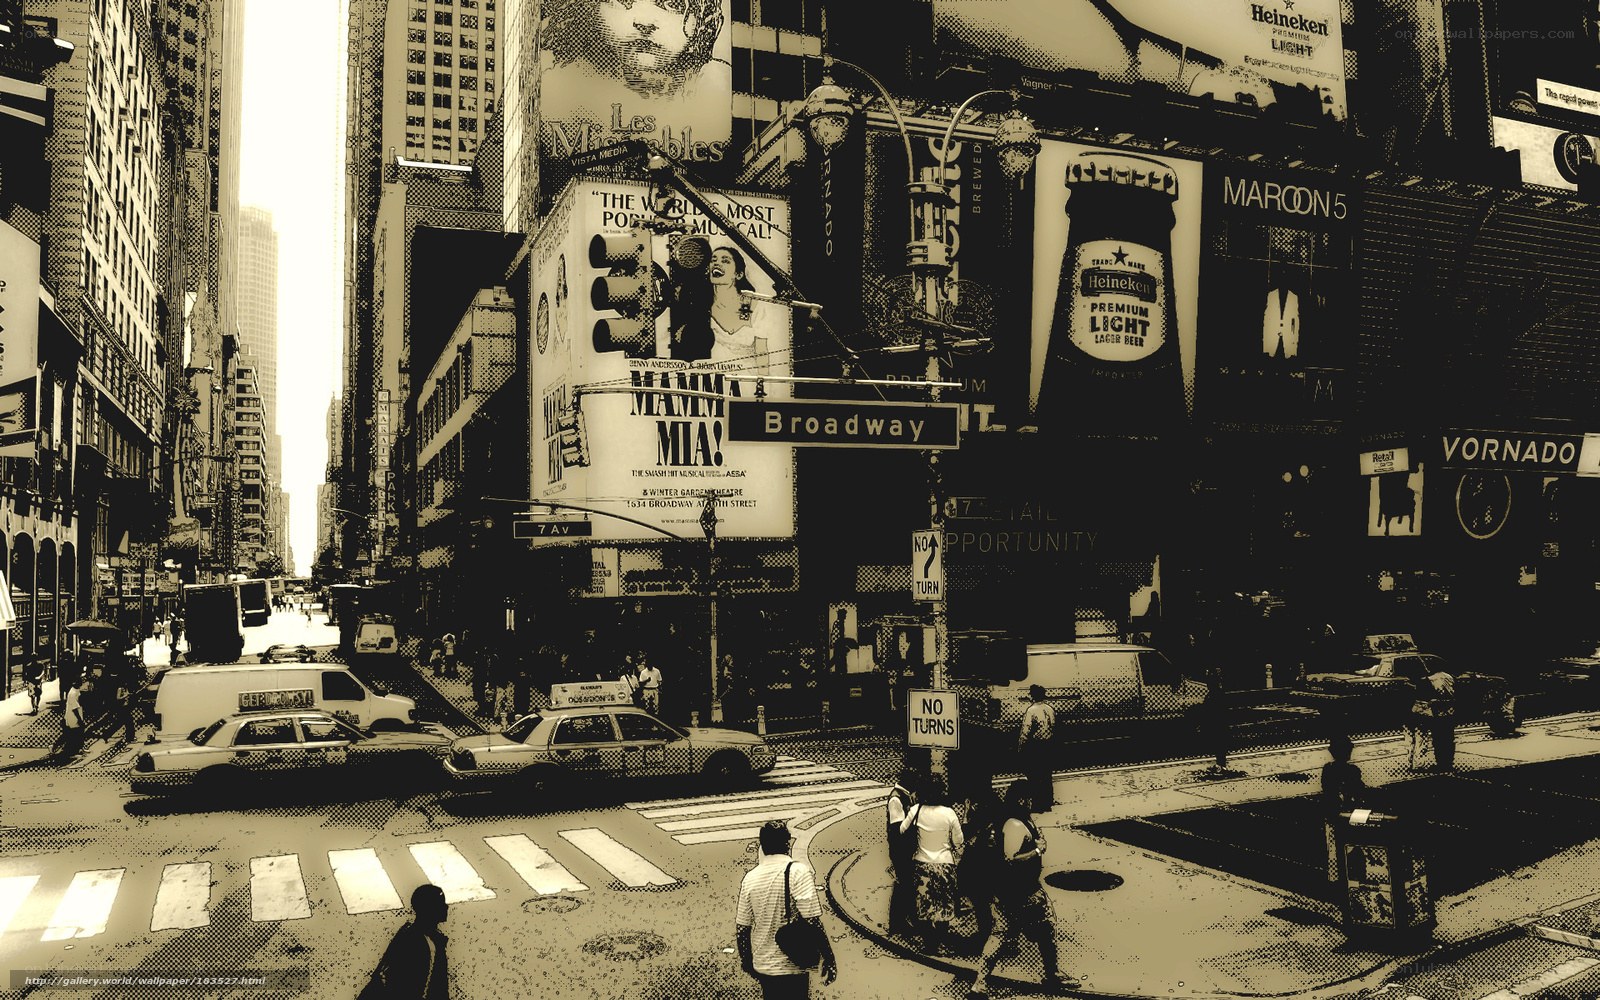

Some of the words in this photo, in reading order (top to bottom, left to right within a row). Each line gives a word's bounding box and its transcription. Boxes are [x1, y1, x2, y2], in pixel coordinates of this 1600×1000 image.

[1251, 4, 1329, 37] Heineken
[1271, 39, 1314, 58] LIGHT
[611, 102, 657, 133] Les
[571, 156, 597, 166] VISTA
[600, 146, 629, 160] MEDIA
[972, 142, 982, 214] BREWED
[1224, 176, 1330, 218] MAROON
[1333, 193, 1347, 220] 5
[726, 203, 775, 222] MOST
[1127, 261, 1146, 271] MARK
[1089, 274, 1151, 295] Heineken
[1090, 302, 1149, 318] PREMIUM
[1090, 315, 1151, 337] LIGHT
[1095, 334, 1121, 344] LAGER
[1124, 335, 1145, 348] BEER
[764, 410, 925, 442] Broadway
[655, 419, 724, 467] MIA!
[1442, 435, 1576, 464] VORNADO
[1372, 451, 1395, 462] Retail
[644, 469, 667, 477] SMASH
[387, 472, 396, 511] PARK
[649, 488, 679, 496] WINTER
[648, 500, 694, 508] BROADWAY
[730, 500, 757, 508] STREET
[537, 524, 546, 534] 7
[550, 524, 569, 534] Av
[914, 536, 929, 553] NO
[916, 580, 939, 595] TURN
[922, 698, 943, 715] NO
[912, 717, 955, 735] TURNS
